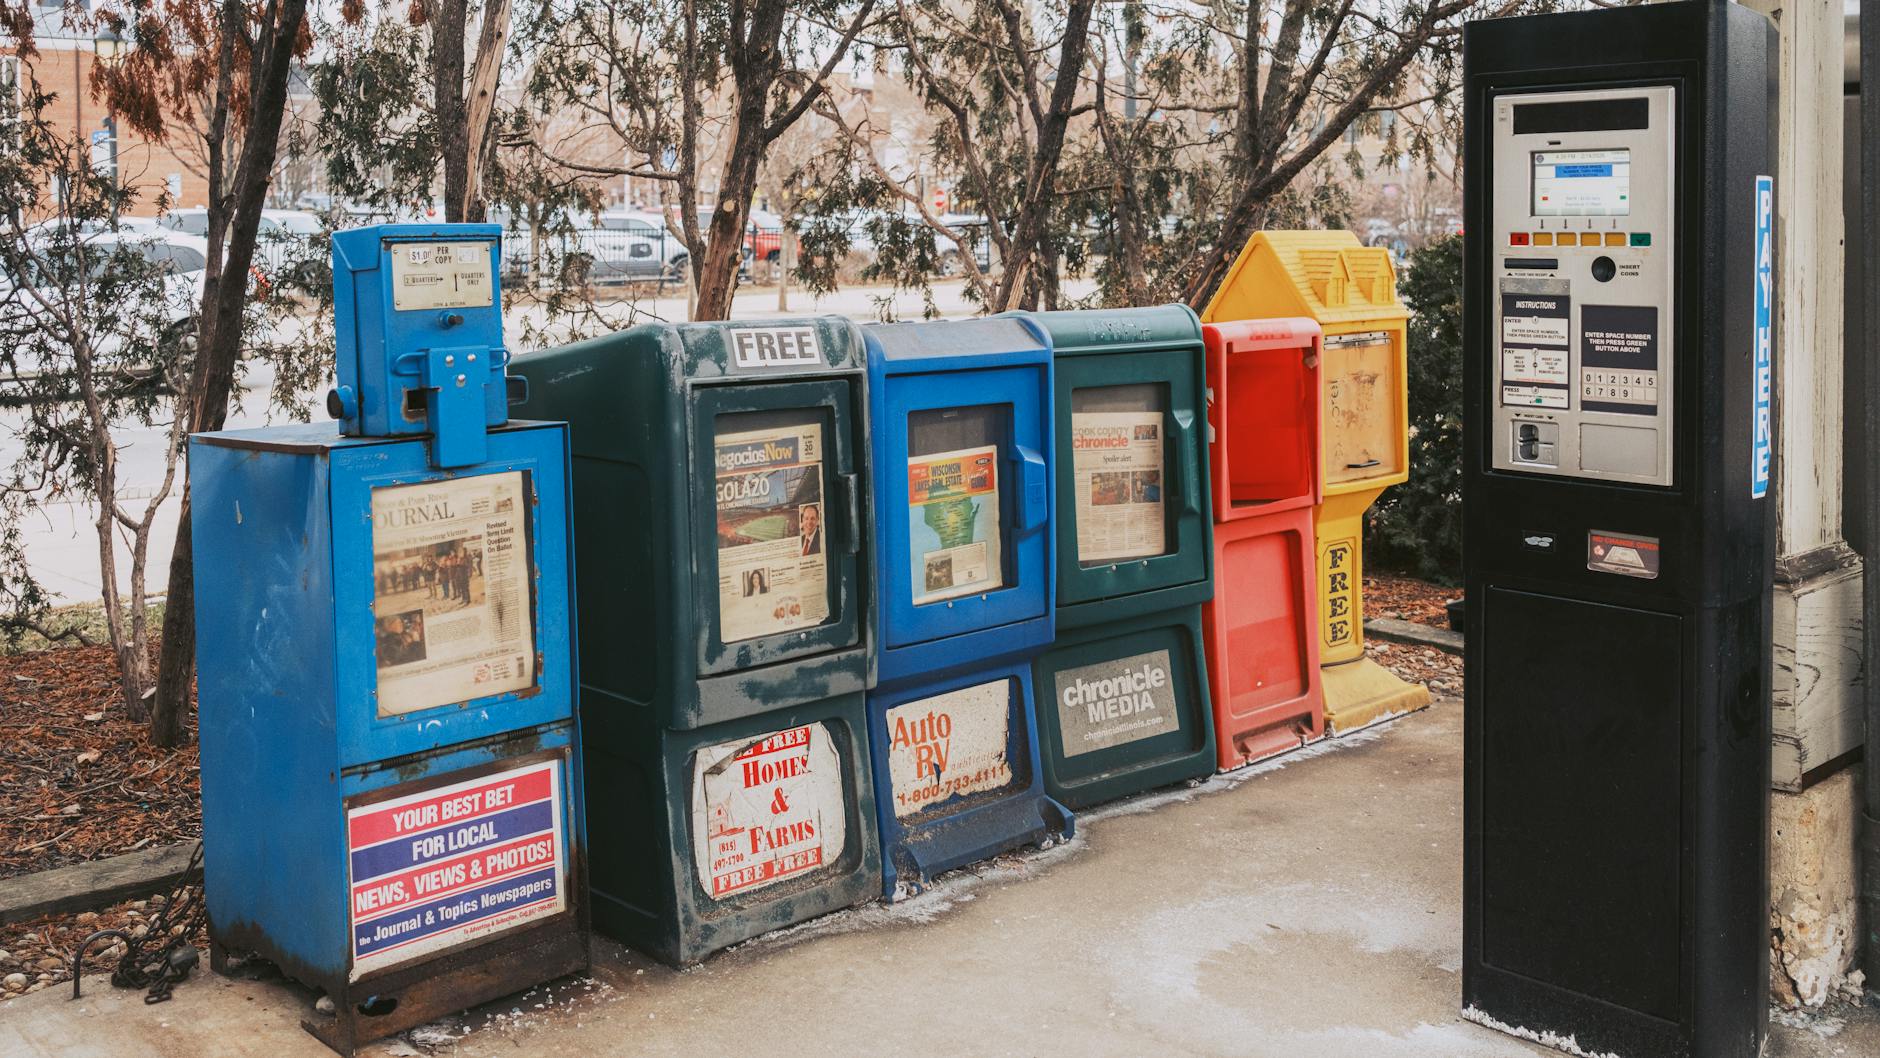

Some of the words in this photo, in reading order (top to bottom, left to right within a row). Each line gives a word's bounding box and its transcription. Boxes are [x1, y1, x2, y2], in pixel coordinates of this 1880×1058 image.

[435, 256, 452, 264] COPY
[437, 246, 449, 254] PER
[1759, 190, 1770, 308] PAY
[1516, 301, 1557, 310] INSTRUCTIONS
[736, 332, 815, 360] FREE
[1586, 374, 1591, 382] 0
[1598, 375, 1602, 383] 1
[1611, 376, 1616, 384] 2
[1623, 376, 1628, 384] 3
[1586, 387, 1590, 395] 6
[1610, 389, 1616, 397] 8
[1757, 327, 1770, 482] HERE
[1072, 433, 1128, 448] chronicle
[931, 462, 961, 477] WISCONSIN
[945, 474, 962, 486] ESTATE
[716, 477, 770, 502] GOLAZO
[486, 521, 506, 529] Revised
[501, 527, 514, 535] Limit
[487, 537, 511, 546] Question
[497, 544, 512, 552] Ballot
[1329, 547, 1349, 642] FREE
[1063, 664, 1165, 707] chronicle
[1088, 691, 1155, 723] MEDIA
[762, 728, 806, 752] FREE
[893, 711, 951, 751] Auto
[916, 739, 950, 780] RV
[898, 764, 1005, 806] 1-800-733-4111
[393, 804, 437, 832] YOUR
[442, 793, 482, 820] BEST
[485, 784, 514, 808] BET
[771, 787, 789, 815] &
[413, 837, 444, 861] FOR
[448, 821, 498, 851] LOCAL
[719, 840, 736, 855] (815)
[749, 819, 814, 855] FARMS
[356, 881, 410, 913] NEWS,
[414, 864, 466, 894] VIEWS
[470, 860, 483, 877] &
[486, 840, 552, 875] PHOTOS!
[718, 864, 765, 891] FREE
[772, 849, 818, 874] FREE
[359, 935, 370, 946] the
[374, 914, 421, 942] Journal
[425, 910, 435, 926] &
[439, 899, 478, 921] Topics
[481, 878, 552, 909] Newspapers
